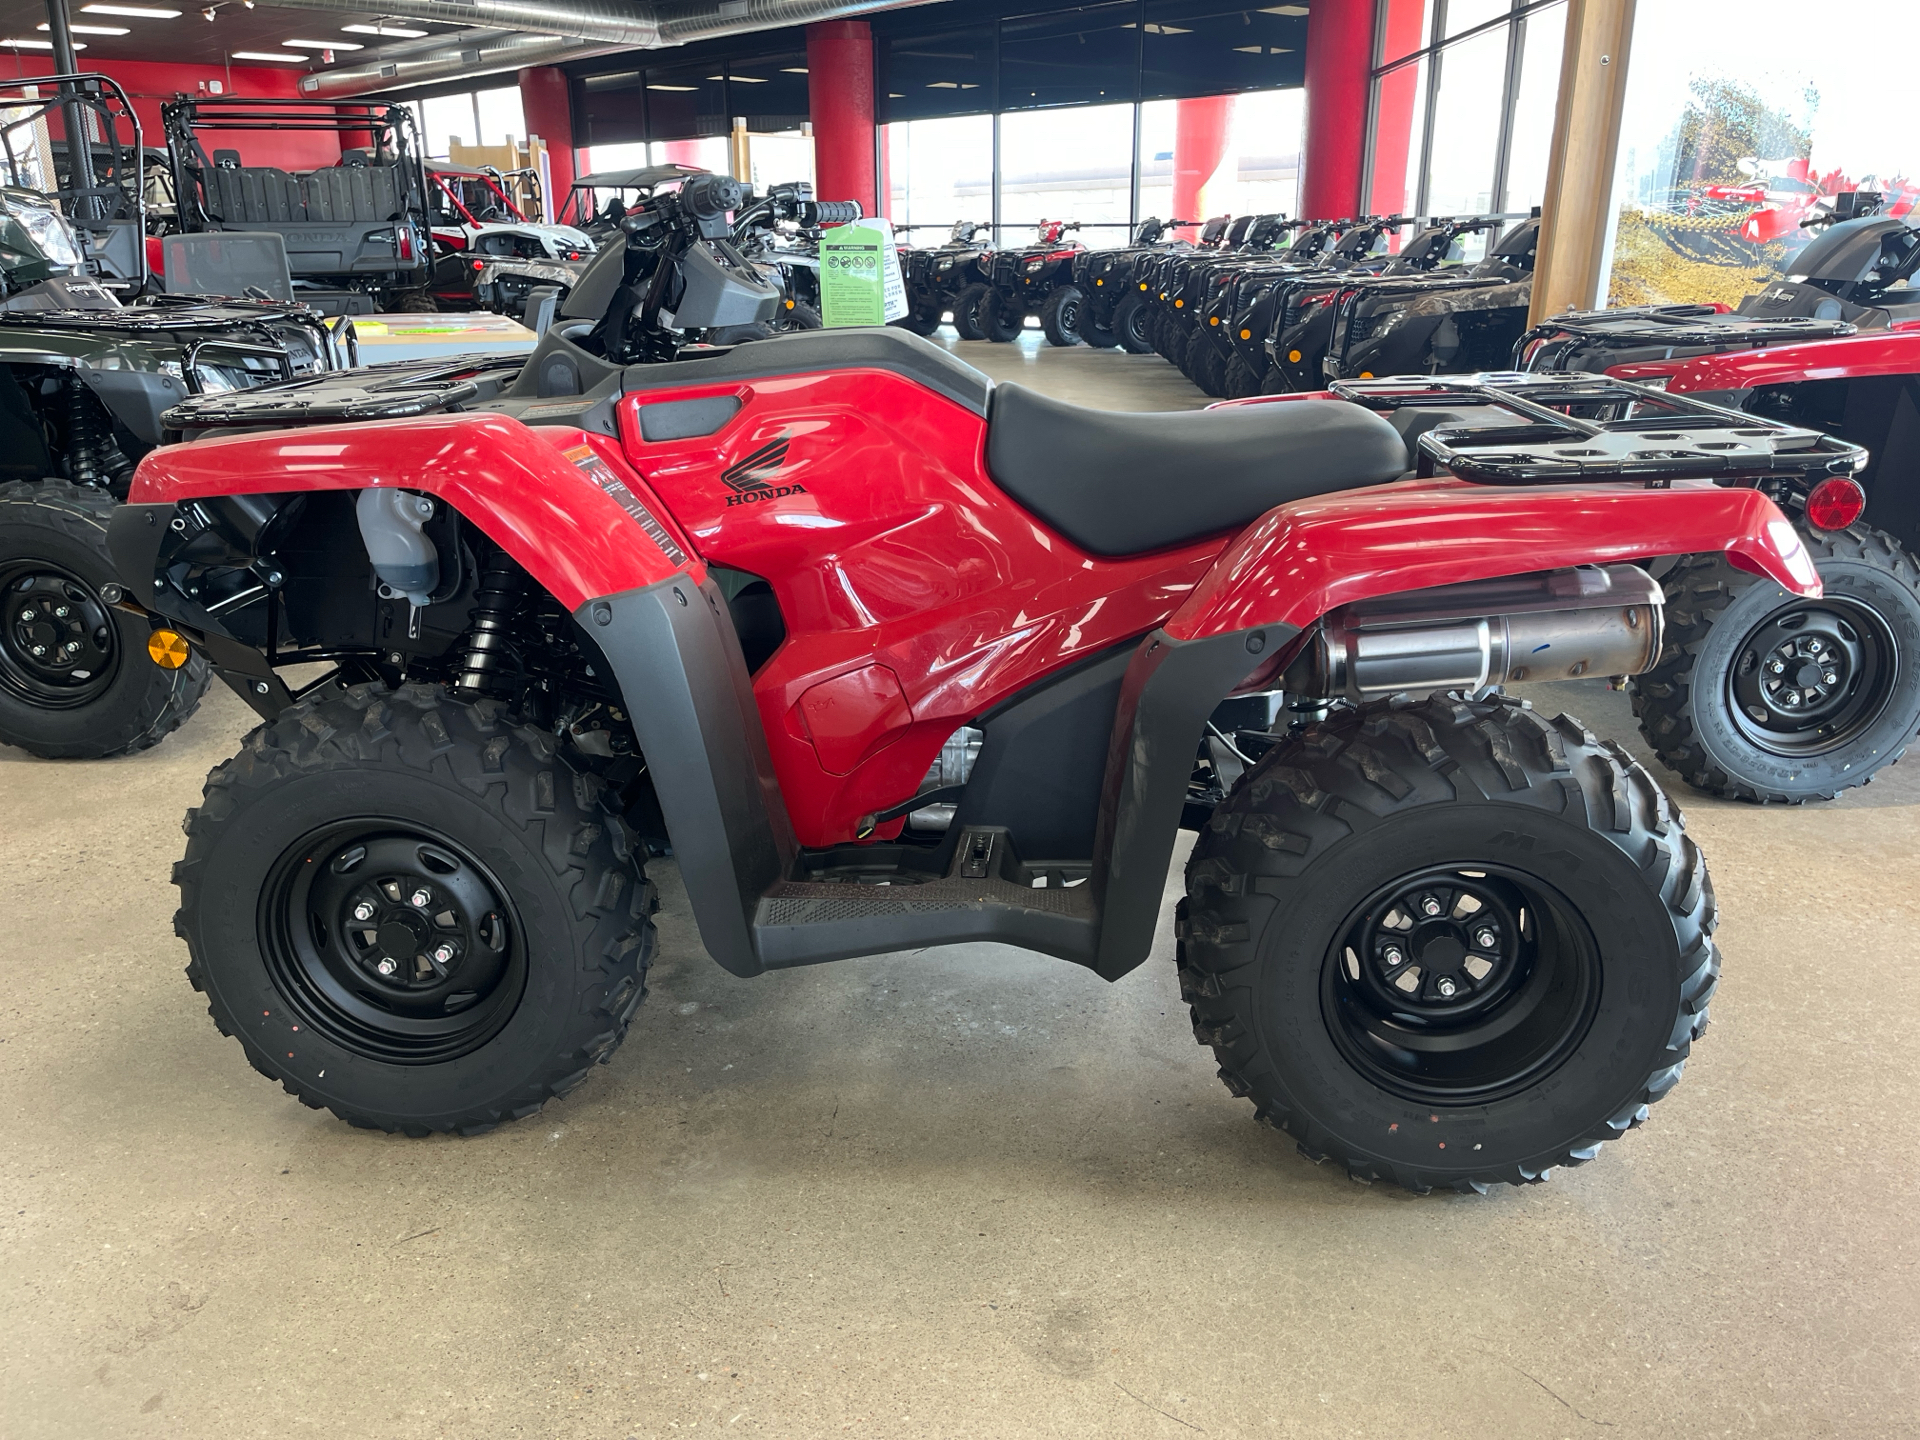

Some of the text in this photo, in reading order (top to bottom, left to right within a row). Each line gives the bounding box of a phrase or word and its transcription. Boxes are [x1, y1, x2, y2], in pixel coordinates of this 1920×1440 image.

[284, 231, 354, 244] ONDA
[288, 347, 311, 360] NDA
[726, 484, 808, 506] HONDA
[1821, 574, 1920, 640] AXXIS
[1485, 829, 1651, 1008] MAXXIS
